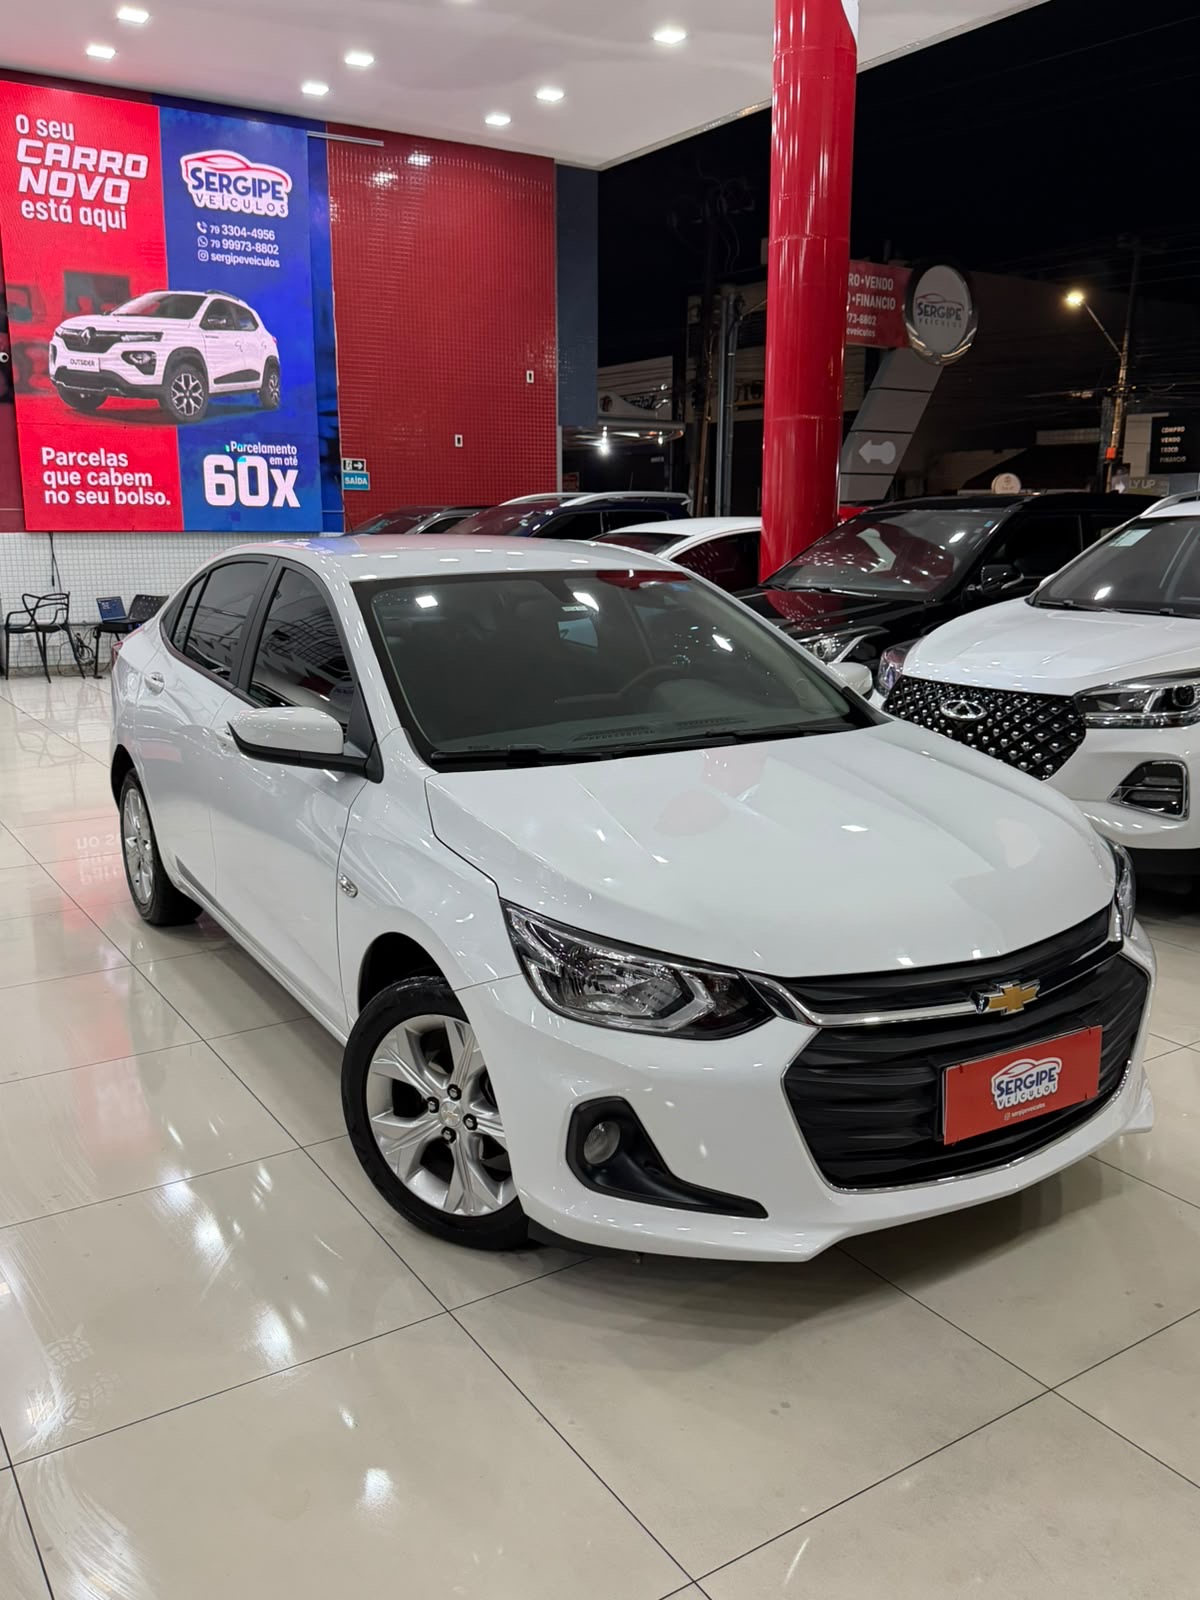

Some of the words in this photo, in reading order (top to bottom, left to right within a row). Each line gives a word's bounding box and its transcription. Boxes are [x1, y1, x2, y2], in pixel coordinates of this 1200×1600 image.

[36, 119, 75, 141] seu
[16, 139, 149, 179] CARRO
[18, 166, 130, 205] NOVO
[190, 167, 284, 200] SERGIPE
[195, 193, 286, 214] VEÍCULOS
[20, 199, 73, 224] está
[79, 205, 127, 233] aqui
[209, 225, 220, 235] 79
[221, 224, 276, 241] 3304-4956
[210, 239, 221, 249] 79
[222, 238, 280, 255] 99973-8802
[210, 252, 281, 268] sergipeveiculos
[848, 273, 860, 287] RO
[865, 276, 894, 291] VENDO
[856, 294, 896, 310] FINANCIO
[847, 313, 876, 325] 73-8802
[917, 302, 962, 321] SERGIPE
[230, 441, 298, 454] Parcelamento
[41, 447, 129, 468] Parcelas
[269, 457, 283, 465] em
[284, 455, 298, 466] até
[43, 471, 82, 490] que
[87, 468, 152, 487] cabem
[344, 475, 368, 486] SAÍDA
[44, 489, 70, 505] no
[75, 490, 111, 505] seu
[115, 488, 171, 506] bolso.
[996, 1067, 1057, 1098] SERGIPE
